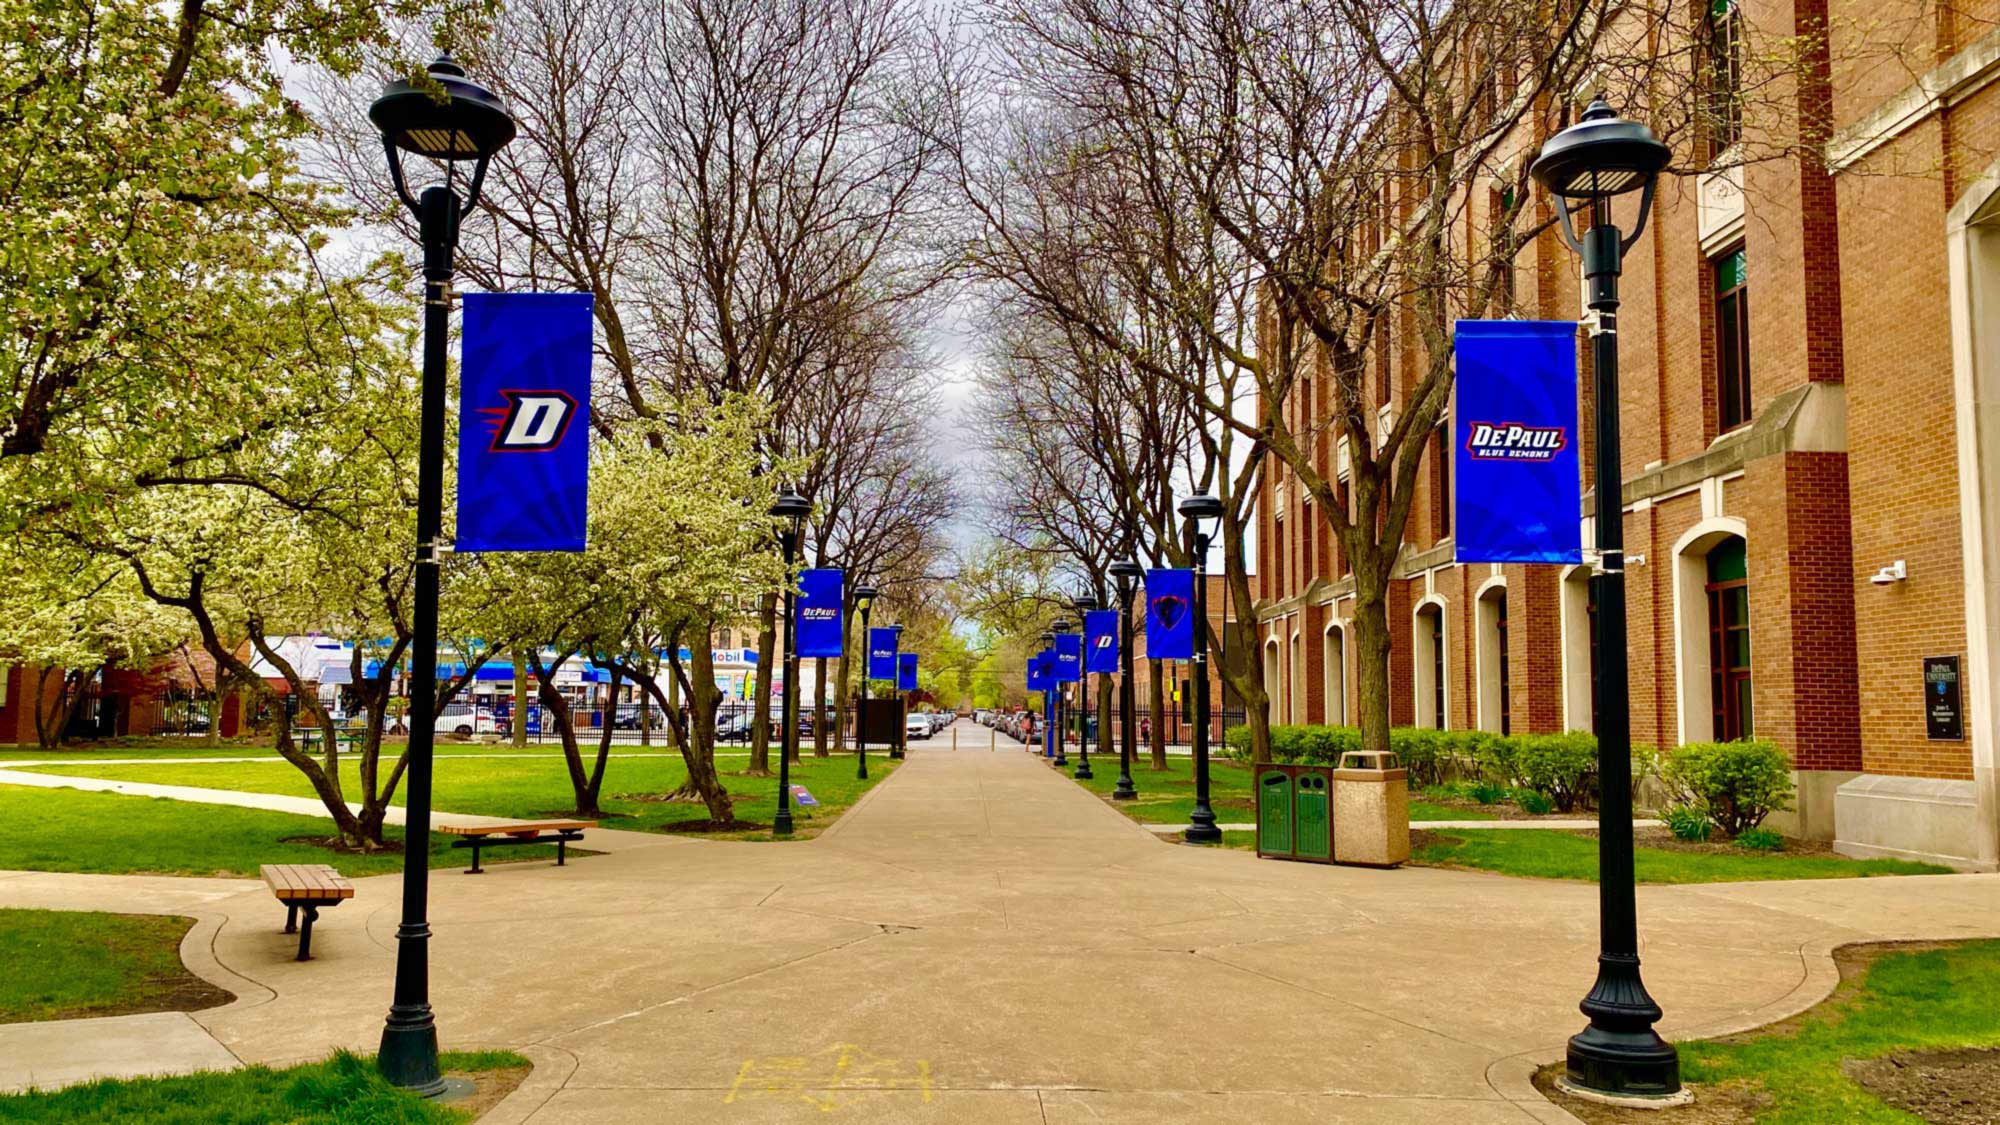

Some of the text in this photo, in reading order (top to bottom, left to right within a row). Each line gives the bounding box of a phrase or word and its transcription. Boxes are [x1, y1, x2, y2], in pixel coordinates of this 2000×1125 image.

[503, 396, 568, 445] D
[1471, 425, 1561, 448] DEPAUL
[1478, 448, 1550, 458] BLUE DEMONS
